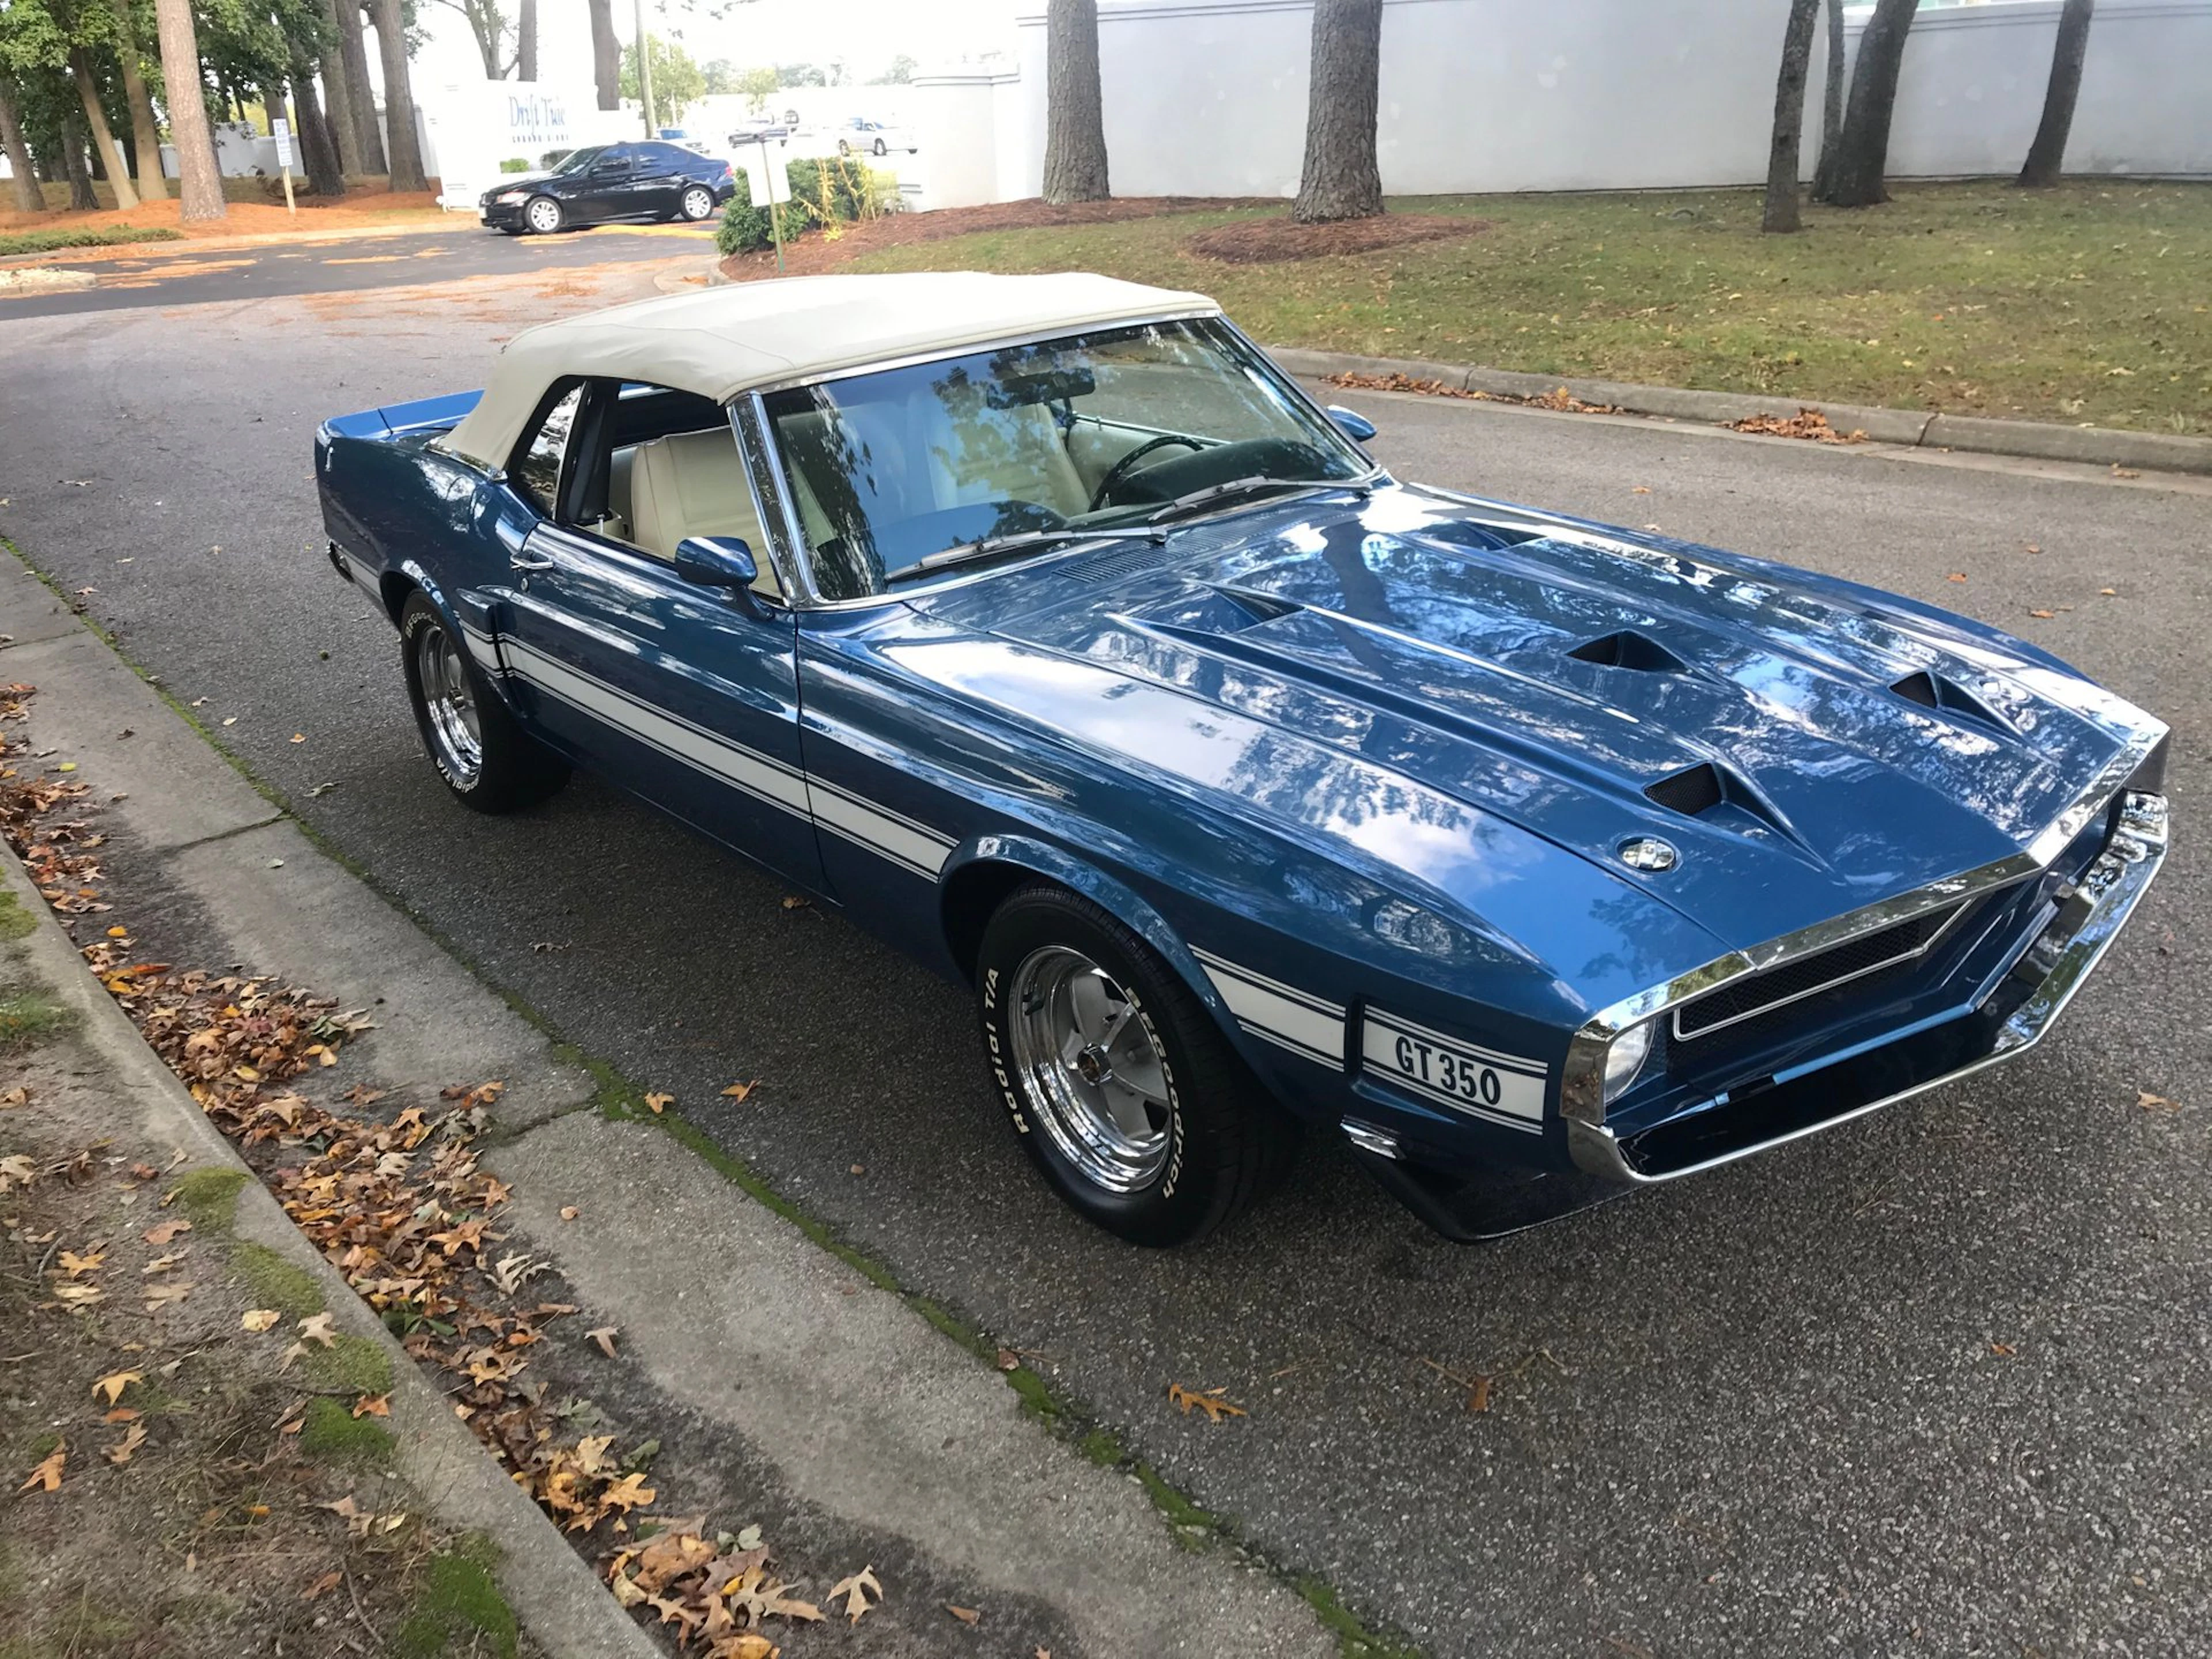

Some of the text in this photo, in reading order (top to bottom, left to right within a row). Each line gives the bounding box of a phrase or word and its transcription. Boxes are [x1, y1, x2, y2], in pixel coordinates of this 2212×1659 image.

[509, 93, 539, 135] Drift
[985, 968, 1030, 1134] Radial T/A
[1396, 1036, 1501, 1105] GT 350
